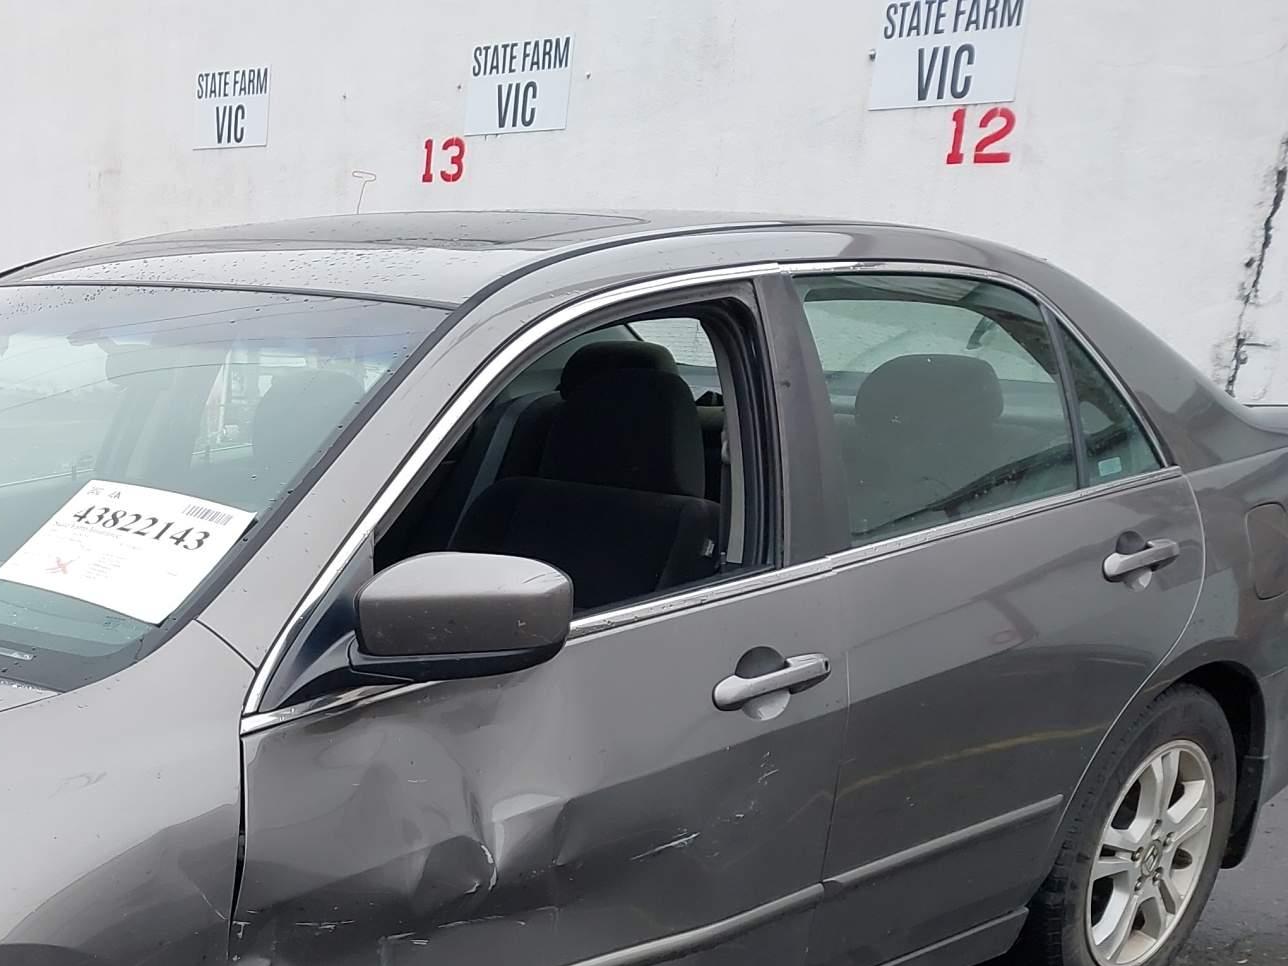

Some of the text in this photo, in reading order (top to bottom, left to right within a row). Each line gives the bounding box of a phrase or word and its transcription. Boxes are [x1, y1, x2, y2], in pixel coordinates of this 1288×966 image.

[882, 0, 1024, 40] STATE FARM
[472, 36, 572, 77] STATE FARM
[916, 43, 976, 102] VIC
[197, 67, 269, 100] STATE FARM
[496, 81, 538, 129] VIC
[215, 104, 246, 144] VIC
[945, 107, 1016, 166] 12
[422, 137, 467, 184] 13
[73, 504, 211, 551] 43822143
